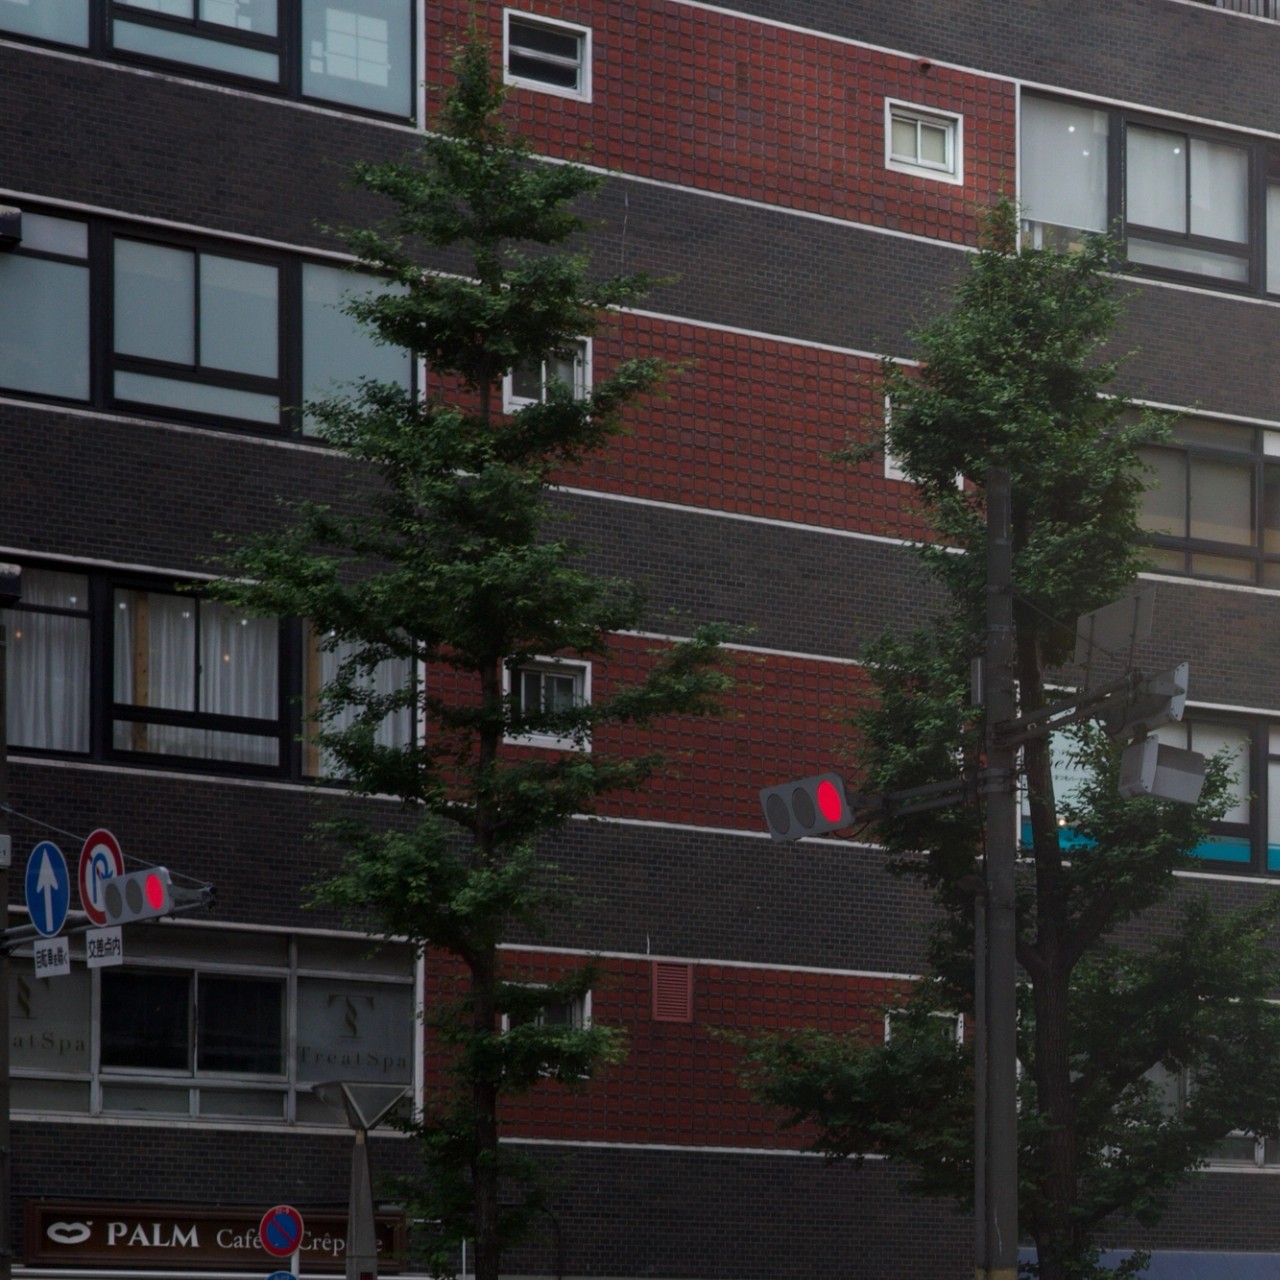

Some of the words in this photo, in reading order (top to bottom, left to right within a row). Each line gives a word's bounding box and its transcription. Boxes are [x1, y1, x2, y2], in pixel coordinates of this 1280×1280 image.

[88, 936, 121, 959] 交差点内
[107, 1221, 201, 1248] PALM
